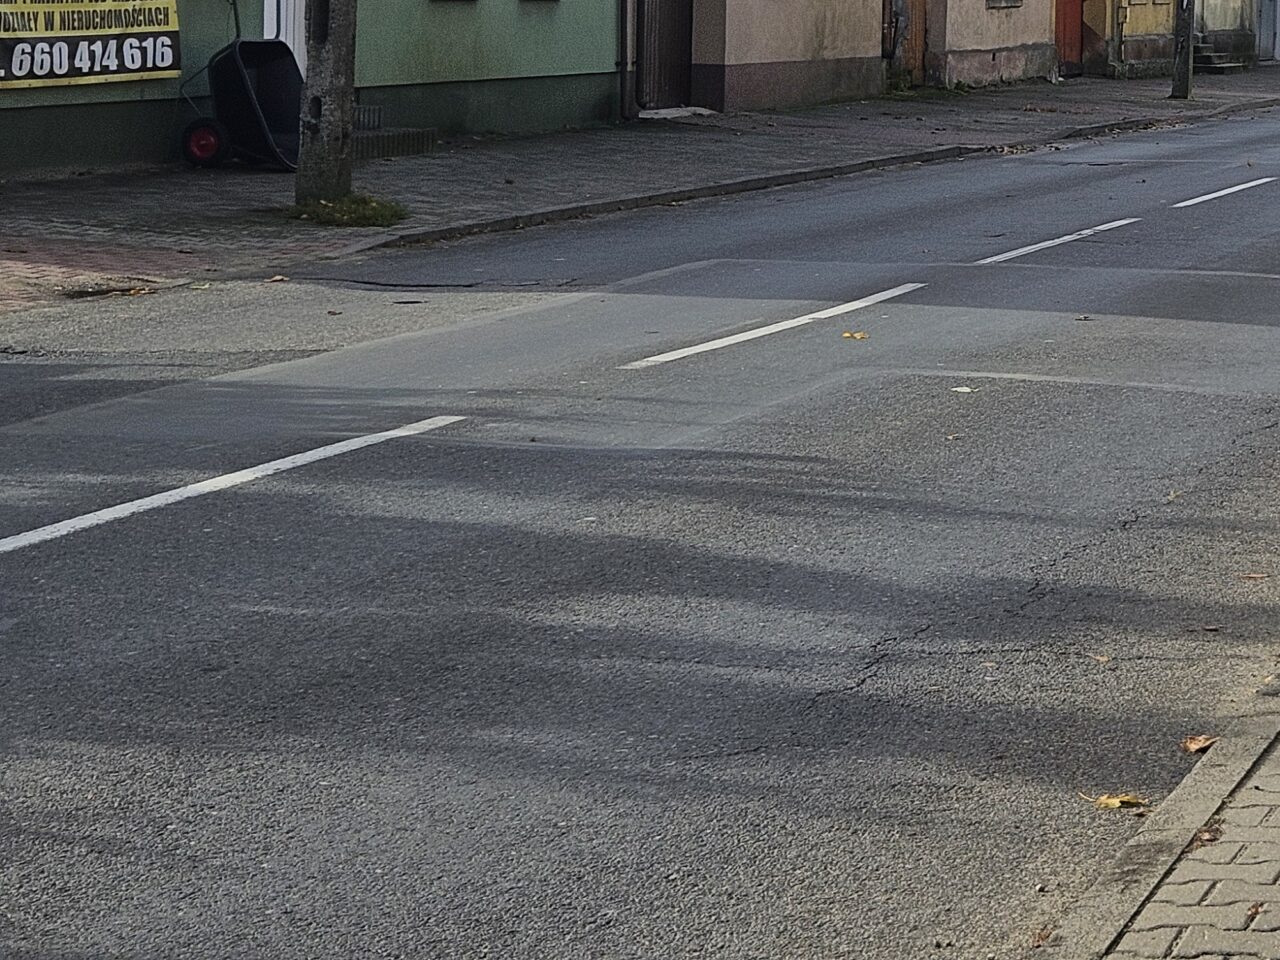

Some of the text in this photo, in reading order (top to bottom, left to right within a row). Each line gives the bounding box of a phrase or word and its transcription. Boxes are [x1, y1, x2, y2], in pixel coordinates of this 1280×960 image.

[0, 5, 170, 32] DZIAŁY W NIERUCHOMOŚCIACH
[11, 36, 173, 77] 660 414 616
